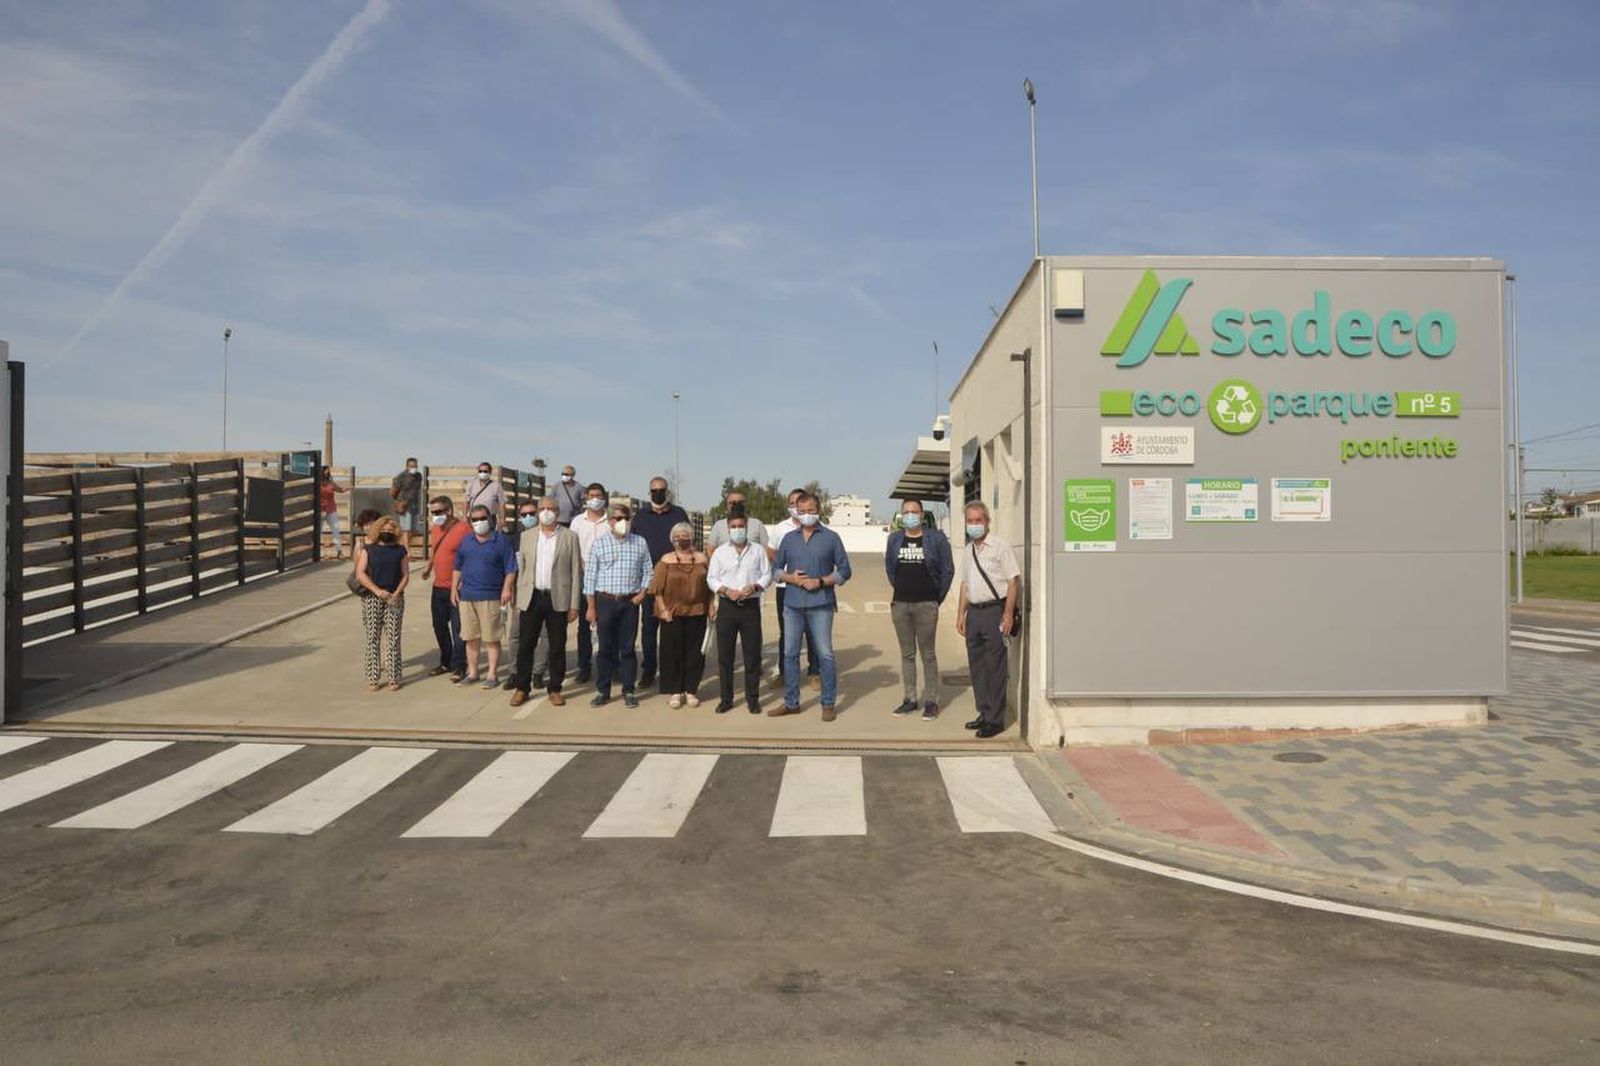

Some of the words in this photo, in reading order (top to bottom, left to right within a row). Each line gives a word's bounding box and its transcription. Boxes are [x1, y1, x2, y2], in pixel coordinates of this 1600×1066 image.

[1210, 290, 1457, 358] sadeco
[1134, 390, 1200, 417] eco
[1268, 390, 1393, 424] parque
[1440, 396, 1452, 413] 5
[1136, 435, 1188, 445] AYUNTAMIENTO
[1341, 435, 1458, 462] poniente
[1136, 445, 1144, 455] DE
[1203, 480, 1241, 490] HORARIO
